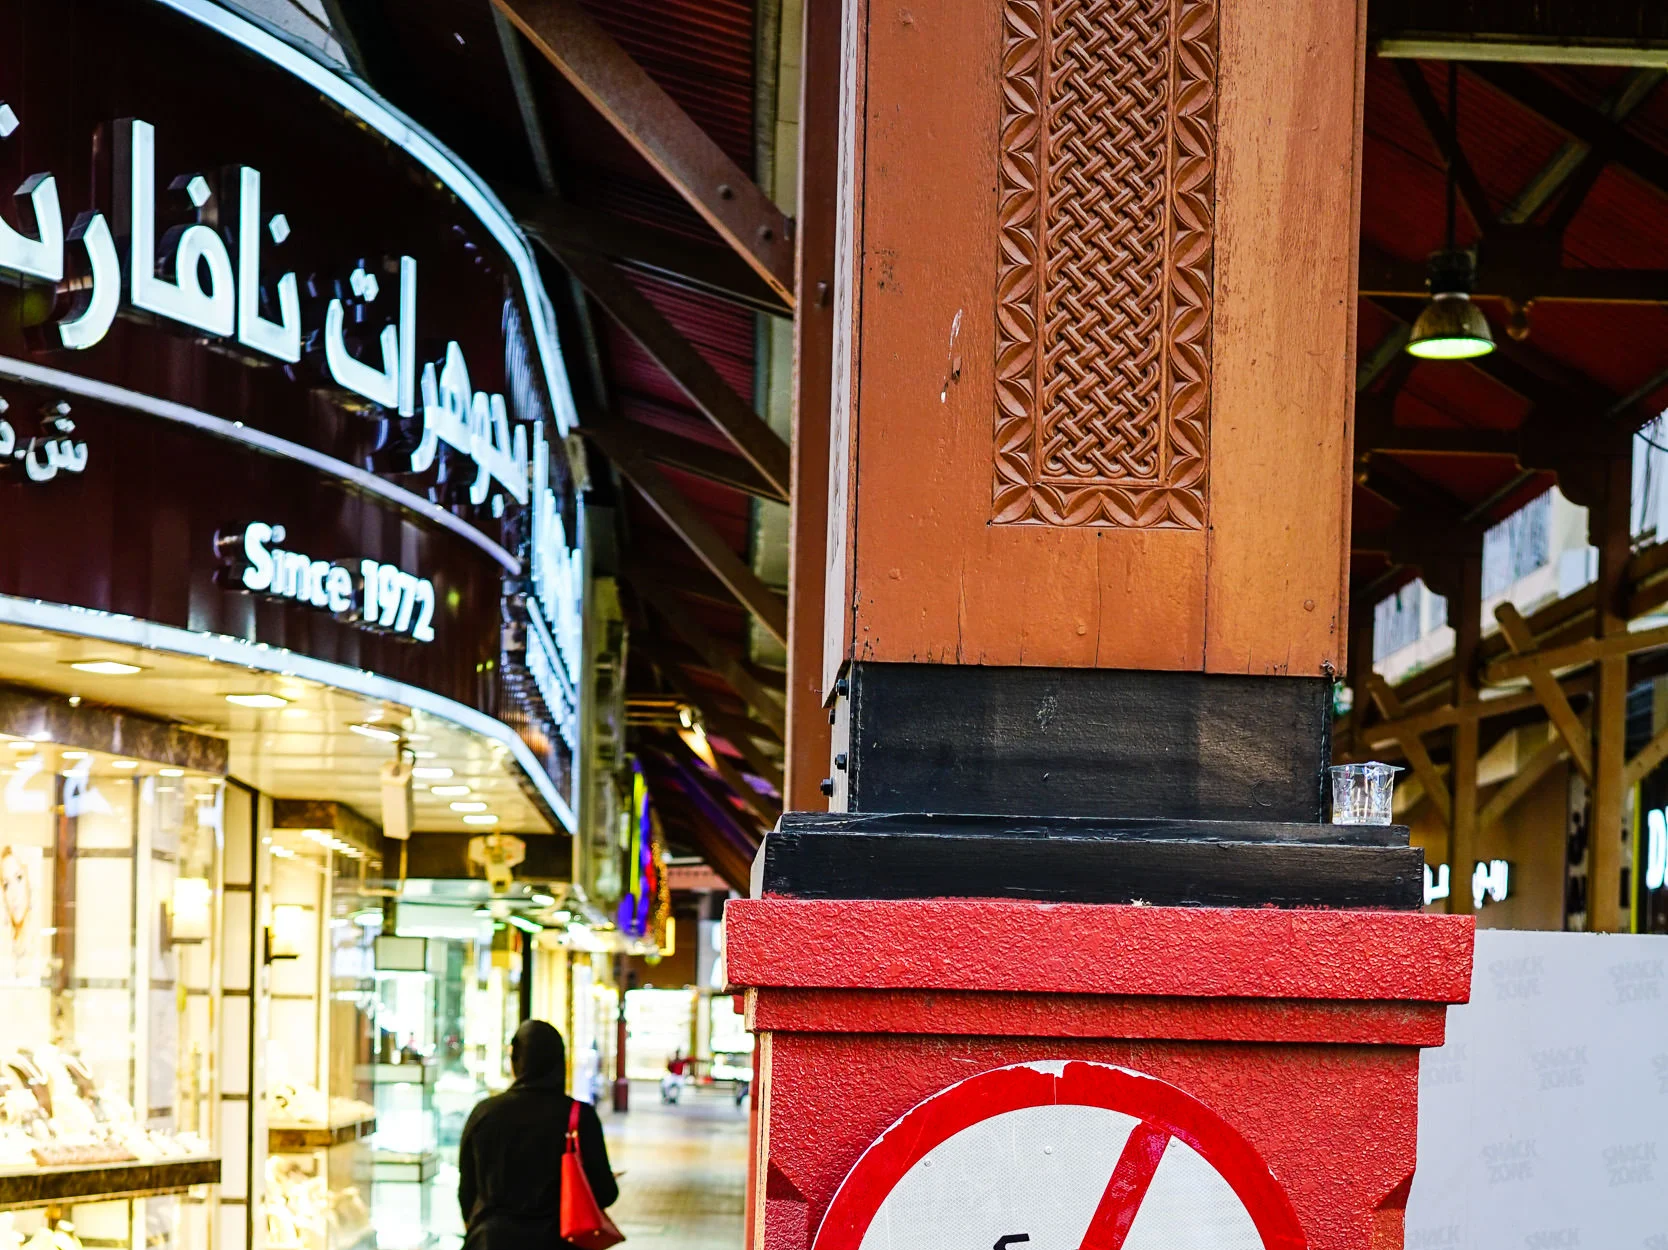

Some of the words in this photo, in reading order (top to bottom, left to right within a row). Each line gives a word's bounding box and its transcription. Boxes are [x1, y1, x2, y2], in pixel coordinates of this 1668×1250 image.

[242, 521, 352, 612] Since
[361, 559, 435, 642] 1972
[1489, 956, 1544, 982] SNACK
[1609, 959, 1664, 985] SNACK
[1496, 978, 1541, 1001] ZONE
[1615, 980, 1661, 1005] ZONE
[1421, 1043, 1467, 1067] NACK
[1531, 1045, 1589, 1071] SNACK
[1421, 1064, 1464, 1088] ZONE
[1538, 1067, 1585, 1091] ZONE
[1482, 1139, 1538, 1166] SNACK
[1602, 1142, 1658, 1168] SNACK
[1488, 1161, 1534, 1184] ZONE
[1609, 1163, 1654, 1187] ZONE
[1406, 1225, 1460, 1250] SNACK
